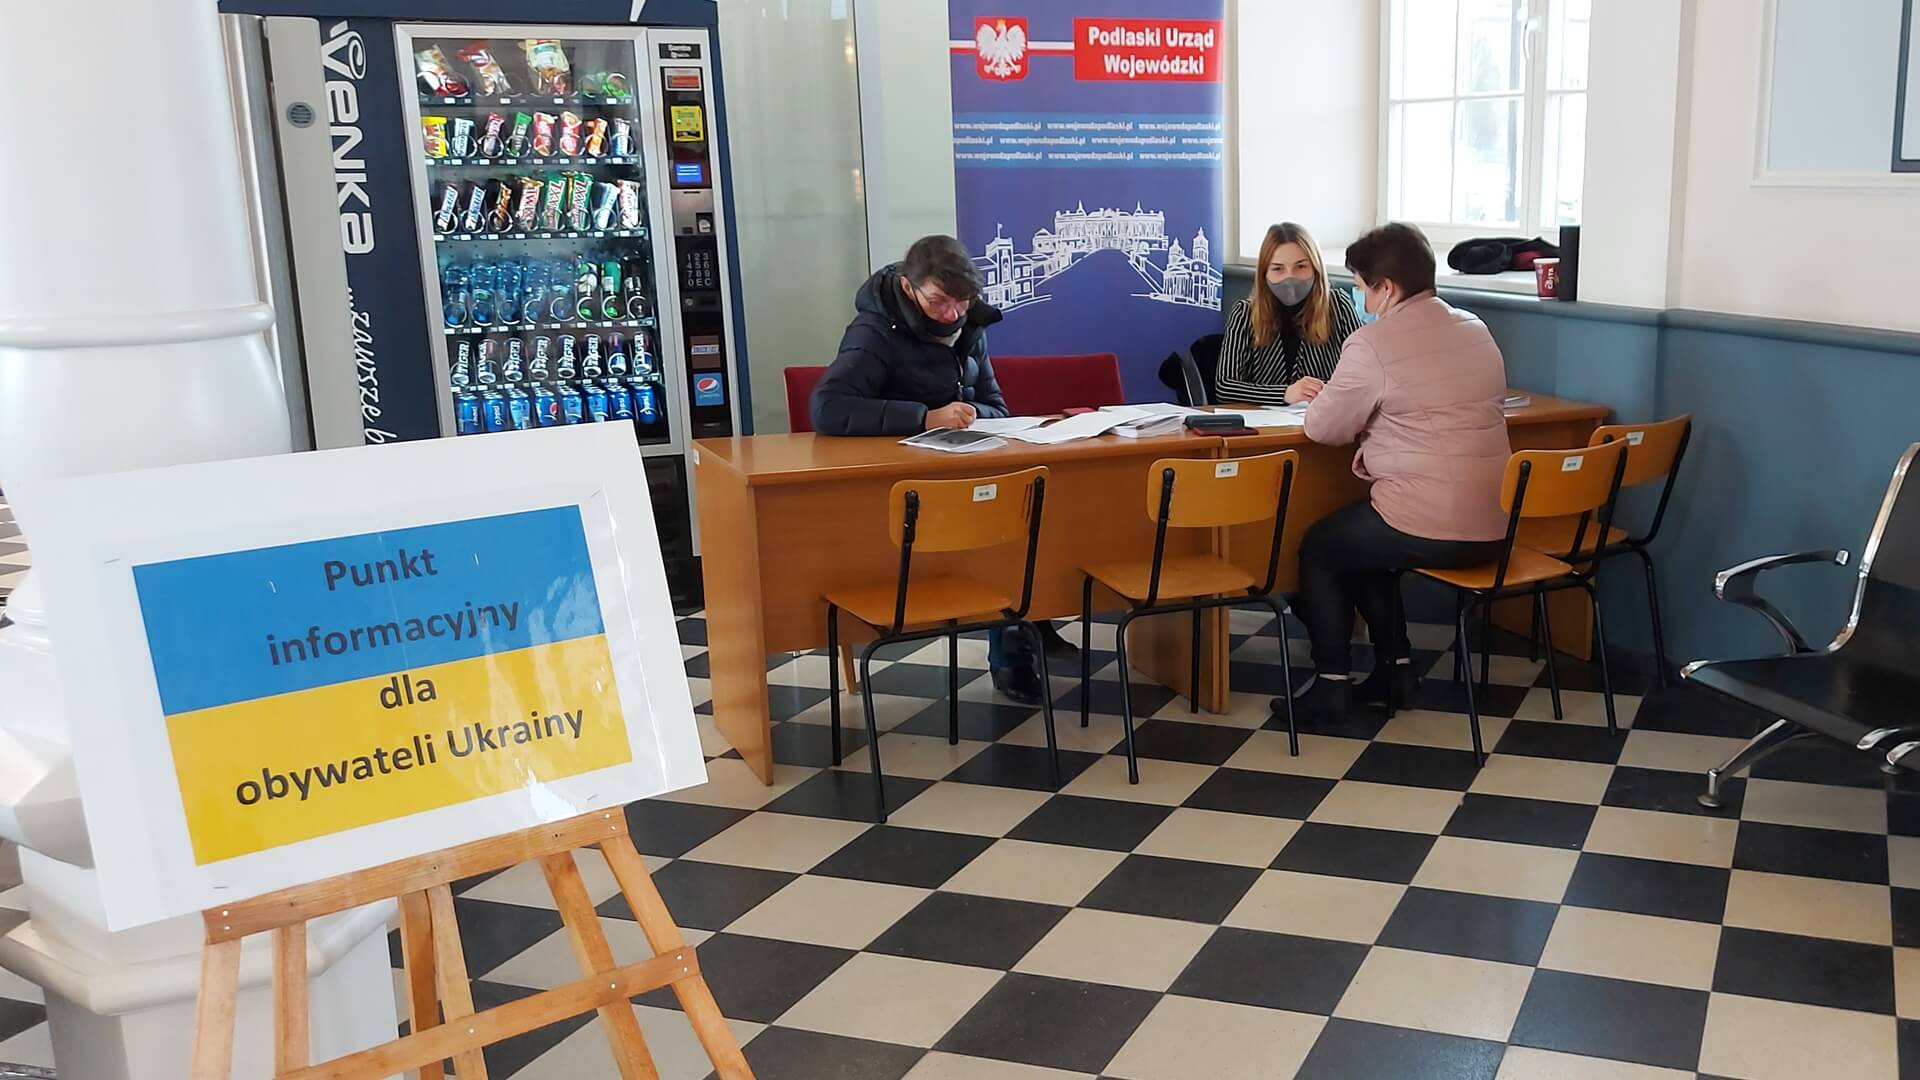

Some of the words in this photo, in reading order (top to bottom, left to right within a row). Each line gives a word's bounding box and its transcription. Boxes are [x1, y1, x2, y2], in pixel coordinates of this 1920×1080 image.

[1088, 26, 1161, 47] Podlaski
[1165, 27, 1214, 52] Urząd
[1104, 54, 1204, 79] Wojewódzki
[458, 343, 470, 374] TIGER
[323, 548, 438, 592] Punkt
[266, 601, 520, 667] informacyjny
[379, 673, 438, 709] dla
[234, 734, 437, 806] obywateli
[447, 708, 585, 759] Ukrainy
